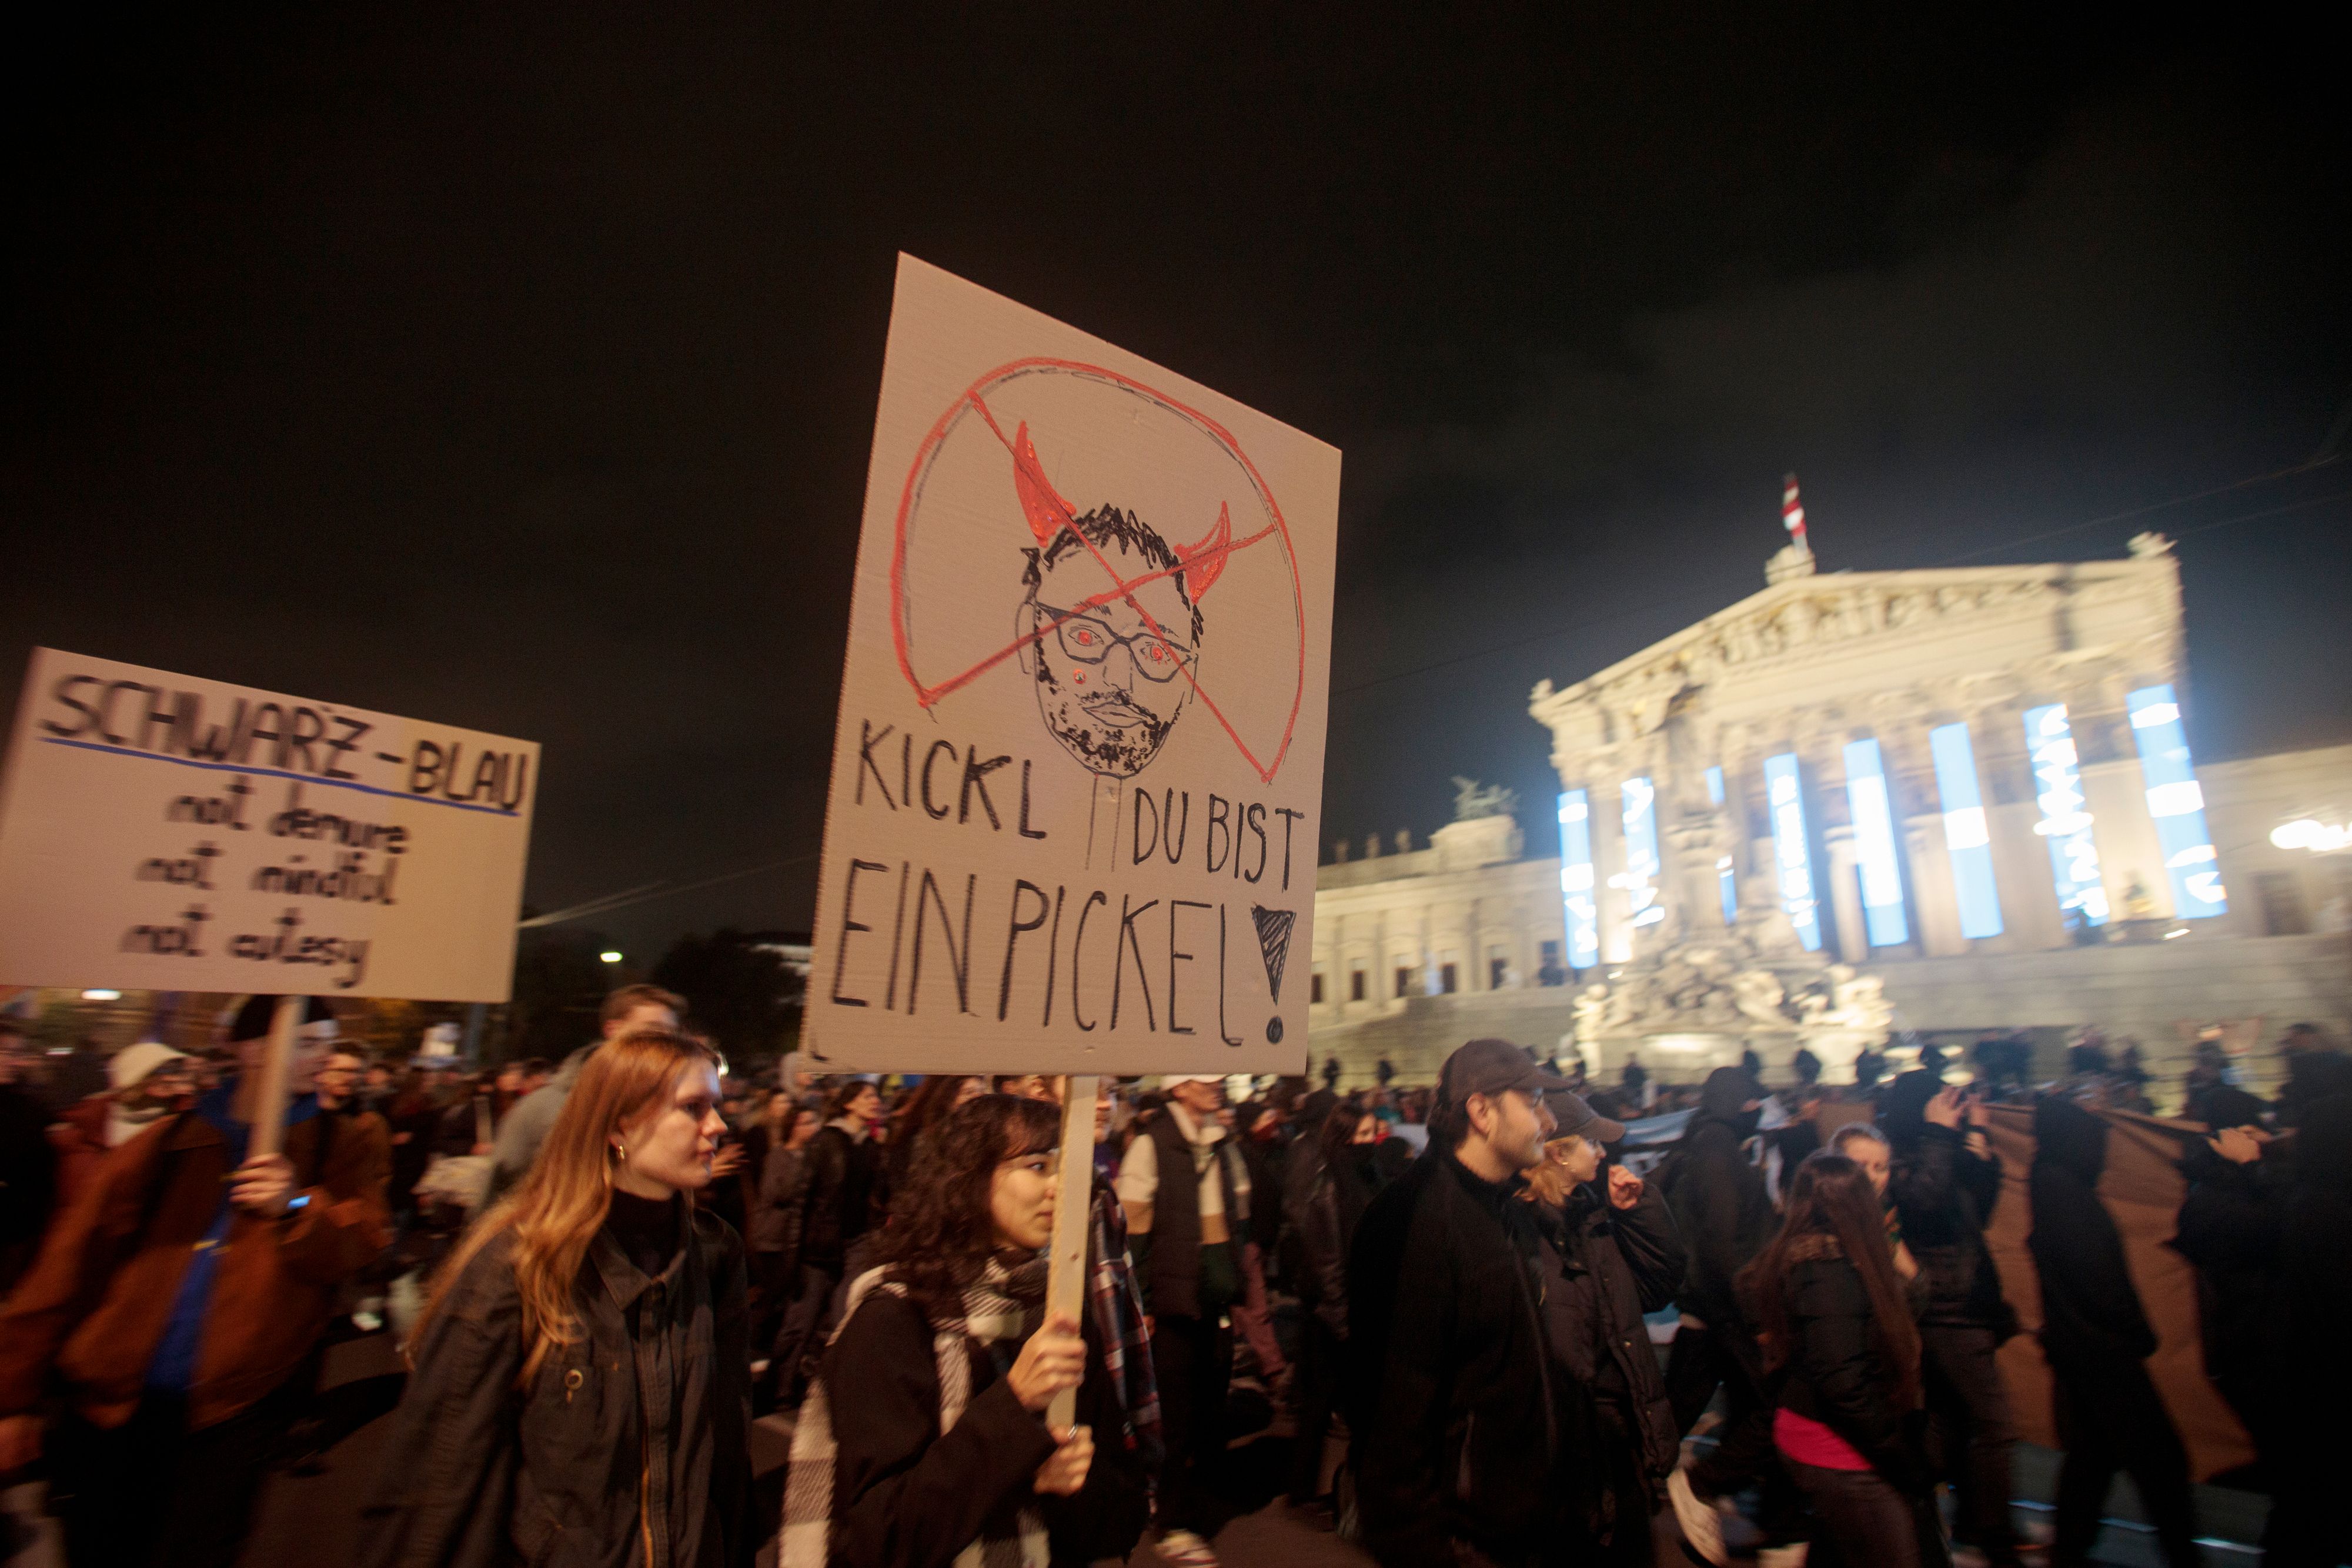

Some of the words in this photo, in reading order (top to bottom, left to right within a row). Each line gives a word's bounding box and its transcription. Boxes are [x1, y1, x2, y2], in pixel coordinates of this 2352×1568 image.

[167, 774, 253, 831] not
[268, 775, 410, 854] demure
[854, 717, 1048, 840] KICKL
[1133, 787, 1188, 865] DU
[1207, 793, 1305, 893] BIST
[135, 840, 220, 890] not
[251, 850, 397, 905] mindful
[121, 903, 209, 957] not
[831, 858, 977, 1017] EIN
[998, 879, 1297, 1047] PICKEL!
